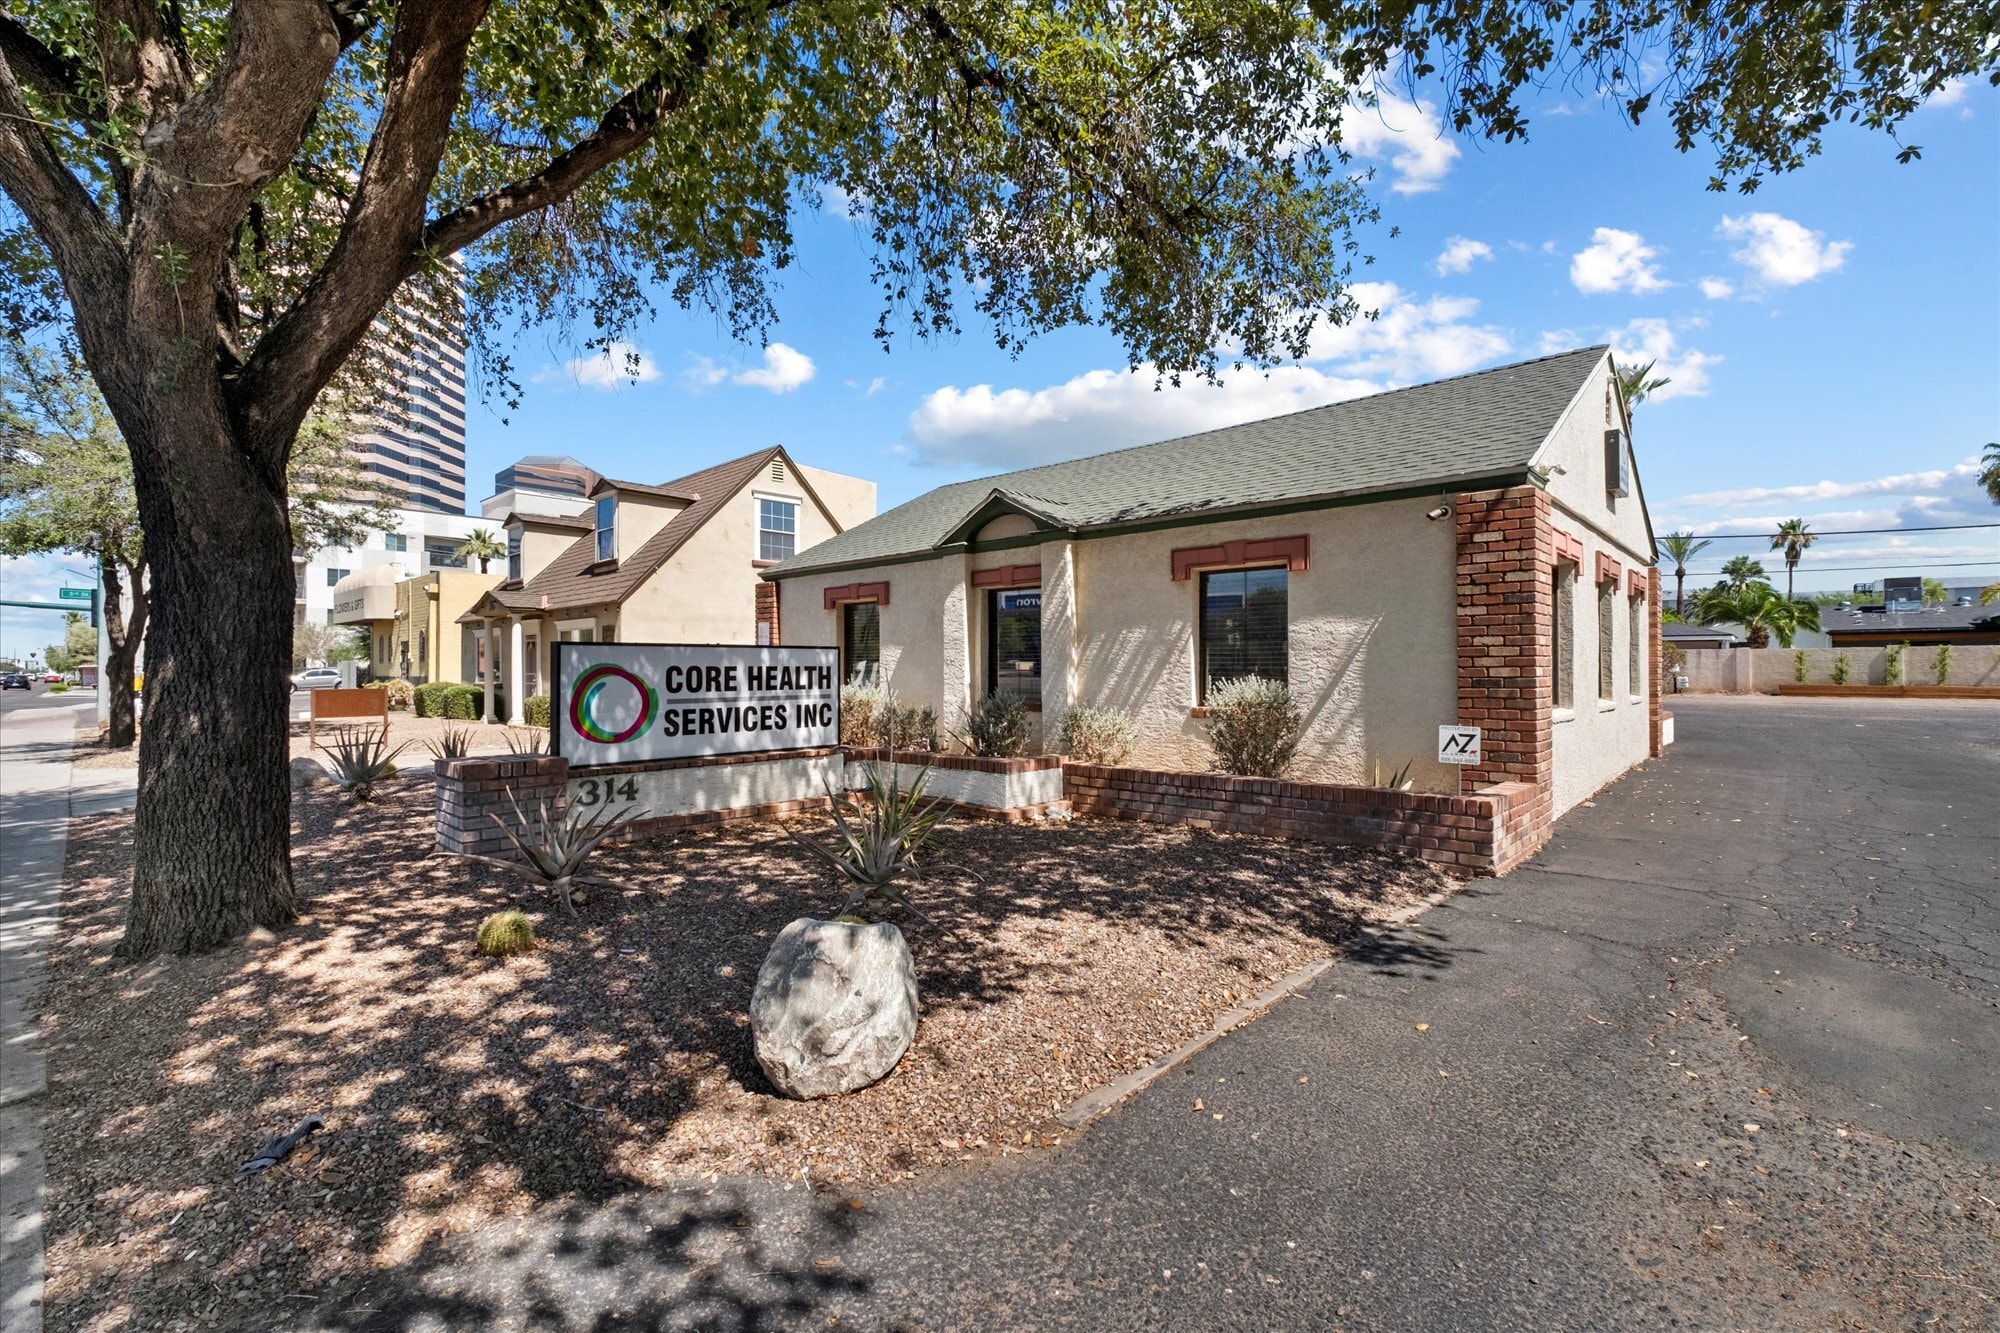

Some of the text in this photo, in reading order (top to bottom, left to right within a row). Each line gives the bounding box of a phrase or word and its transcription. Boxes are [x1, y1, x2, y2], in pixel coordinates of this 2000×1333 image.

[665, 666, 831, 693] CORE HEALTH
[664, 703, 832, 737] SERVICES INC
[1442, 733, 1477, 753] AZ
[576, 774, 639, 806] 314
